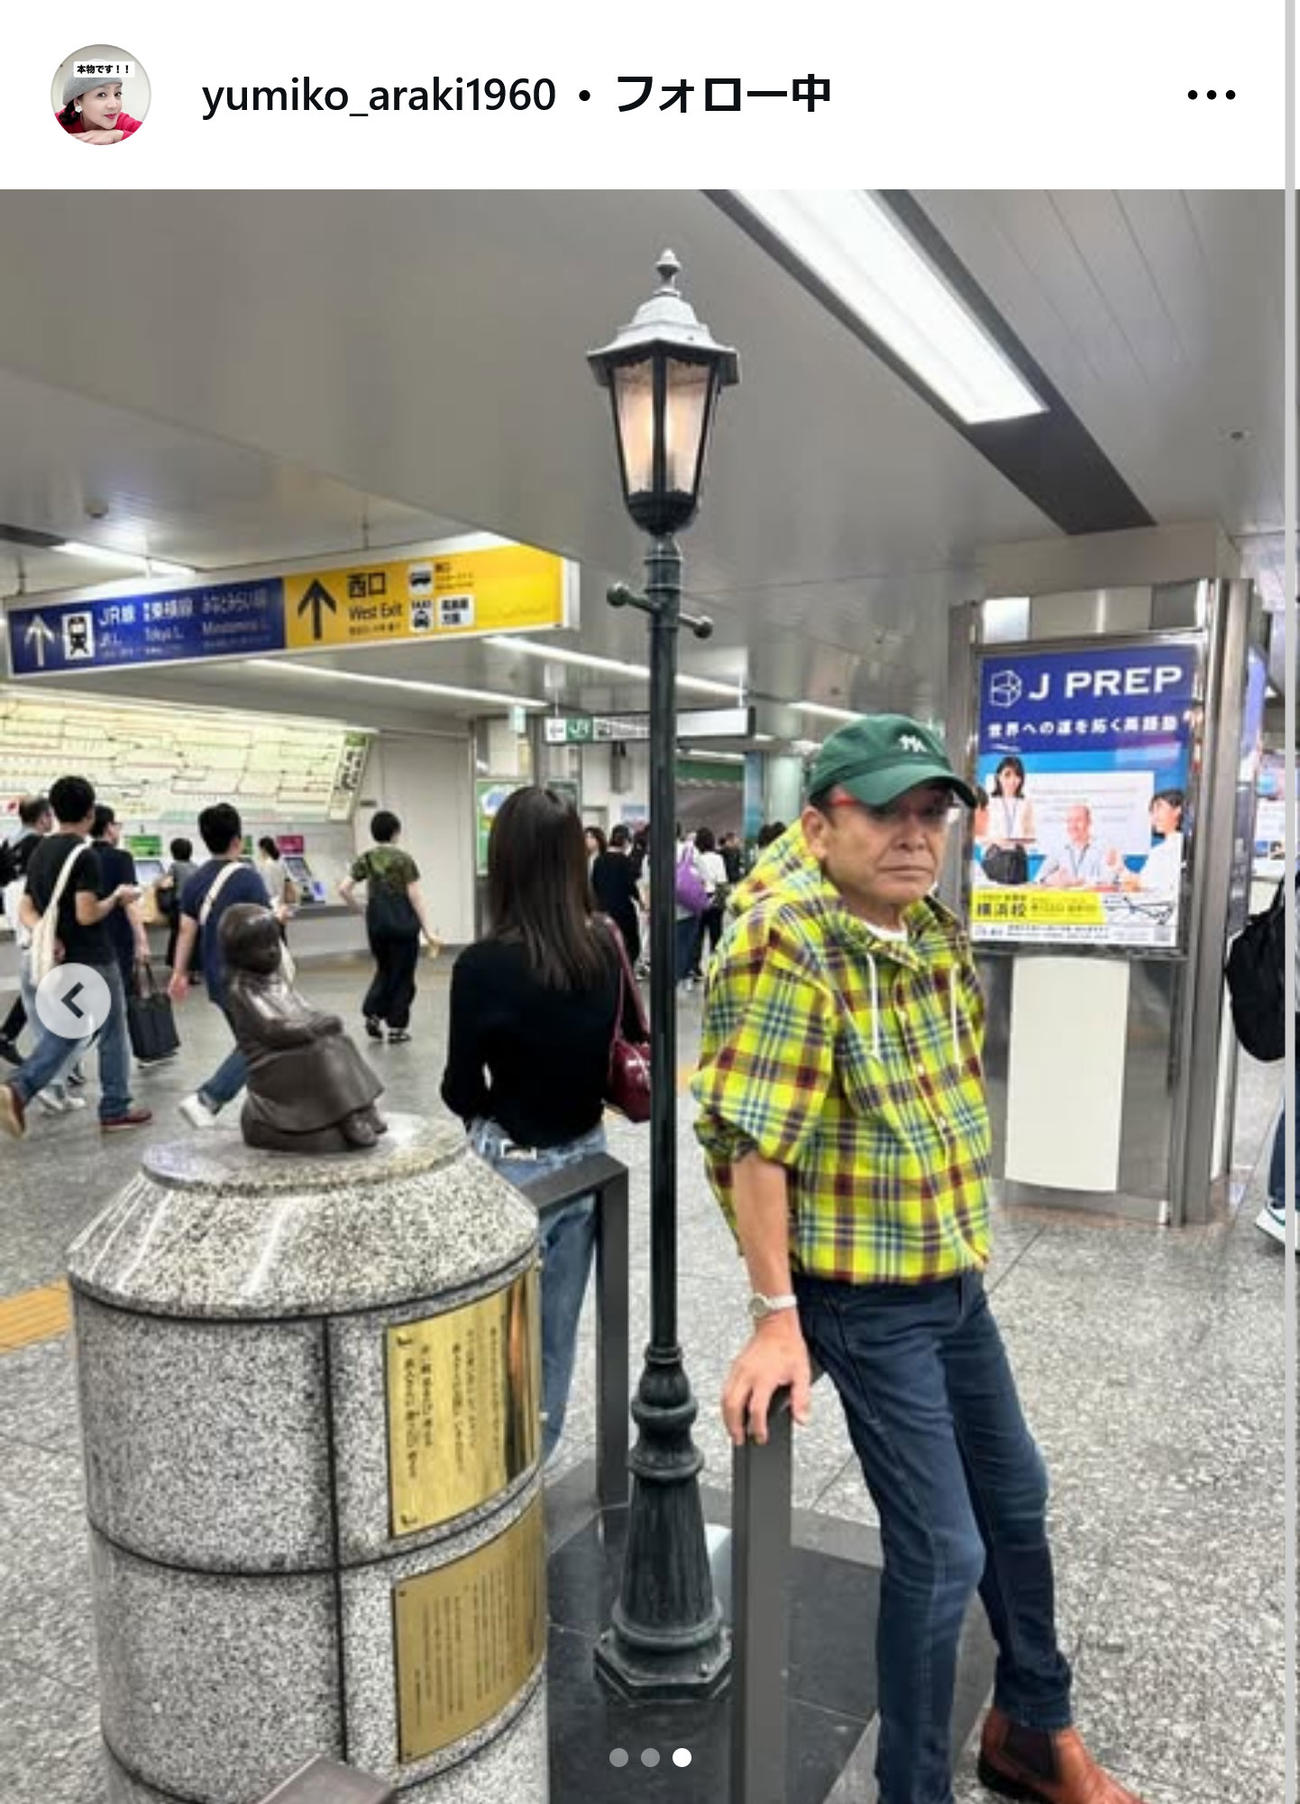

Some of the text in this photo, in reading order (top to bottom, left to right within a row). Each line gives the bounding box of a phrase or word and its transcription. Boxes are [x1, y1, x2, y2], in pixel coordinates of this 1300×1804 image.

[346, 572, 387, 599] 西口
[349, 602, 402, 622] West Exit
[1029, 666, 1182, 701] J PREP
